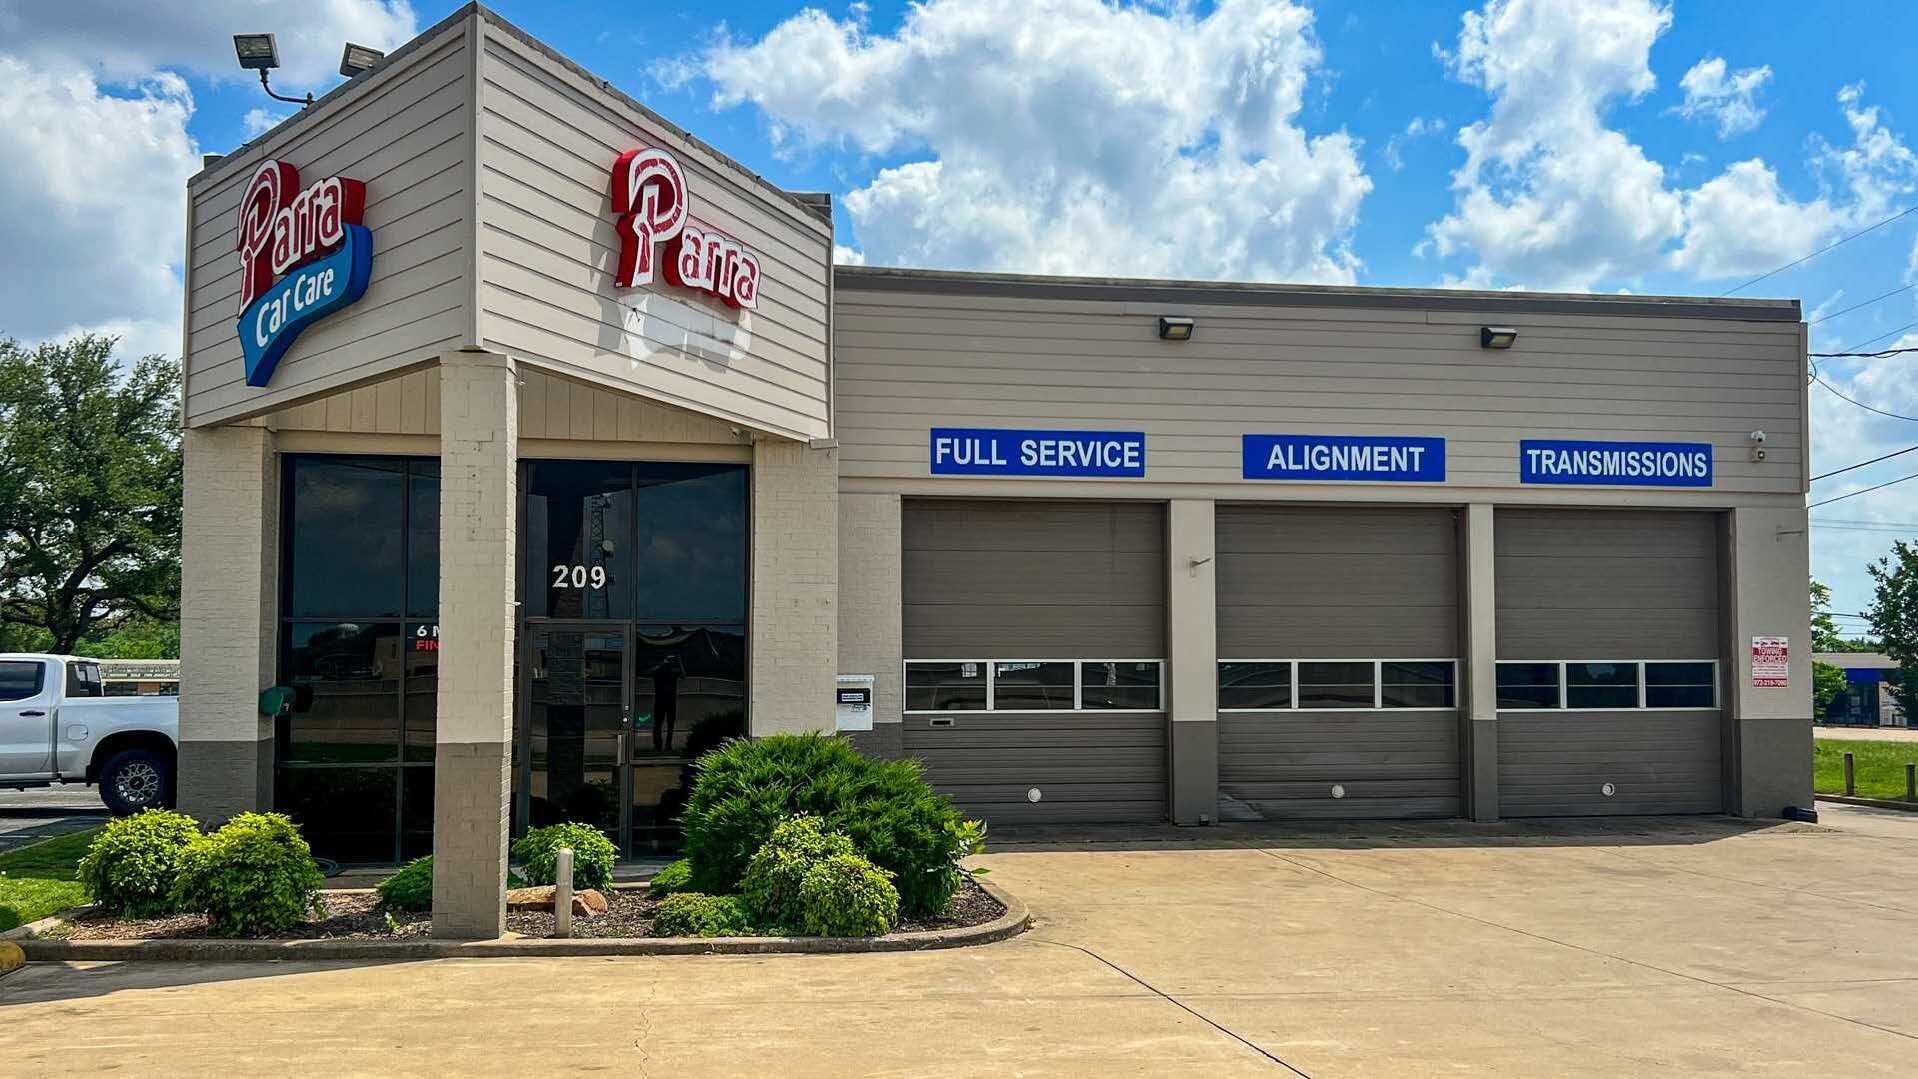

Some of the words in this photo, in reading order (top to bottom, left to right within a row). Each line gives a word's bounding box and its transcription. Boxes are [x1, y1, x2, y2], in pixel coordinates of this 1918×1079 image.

[237, 159, 345, 318] Parra
[625, 147, 761, 310] Parra
[256, 288, 290, 348] Car
[294, 268, 334, 312] Care
[935, 438, 1007, 465] FULL
[1020, 439, 1141, 468] SERVICE
[1266, 444, 1425, 472] ALIGNMENT
[1526, 449, 1708, 478] TRANSMISSIONS
[552, 565, 607, 590] 209
[416, 625, 428, 637] 6
[1752, 655, 1788, 663] ENFORCED
[1758, 648, 1783, 656] TOWING
